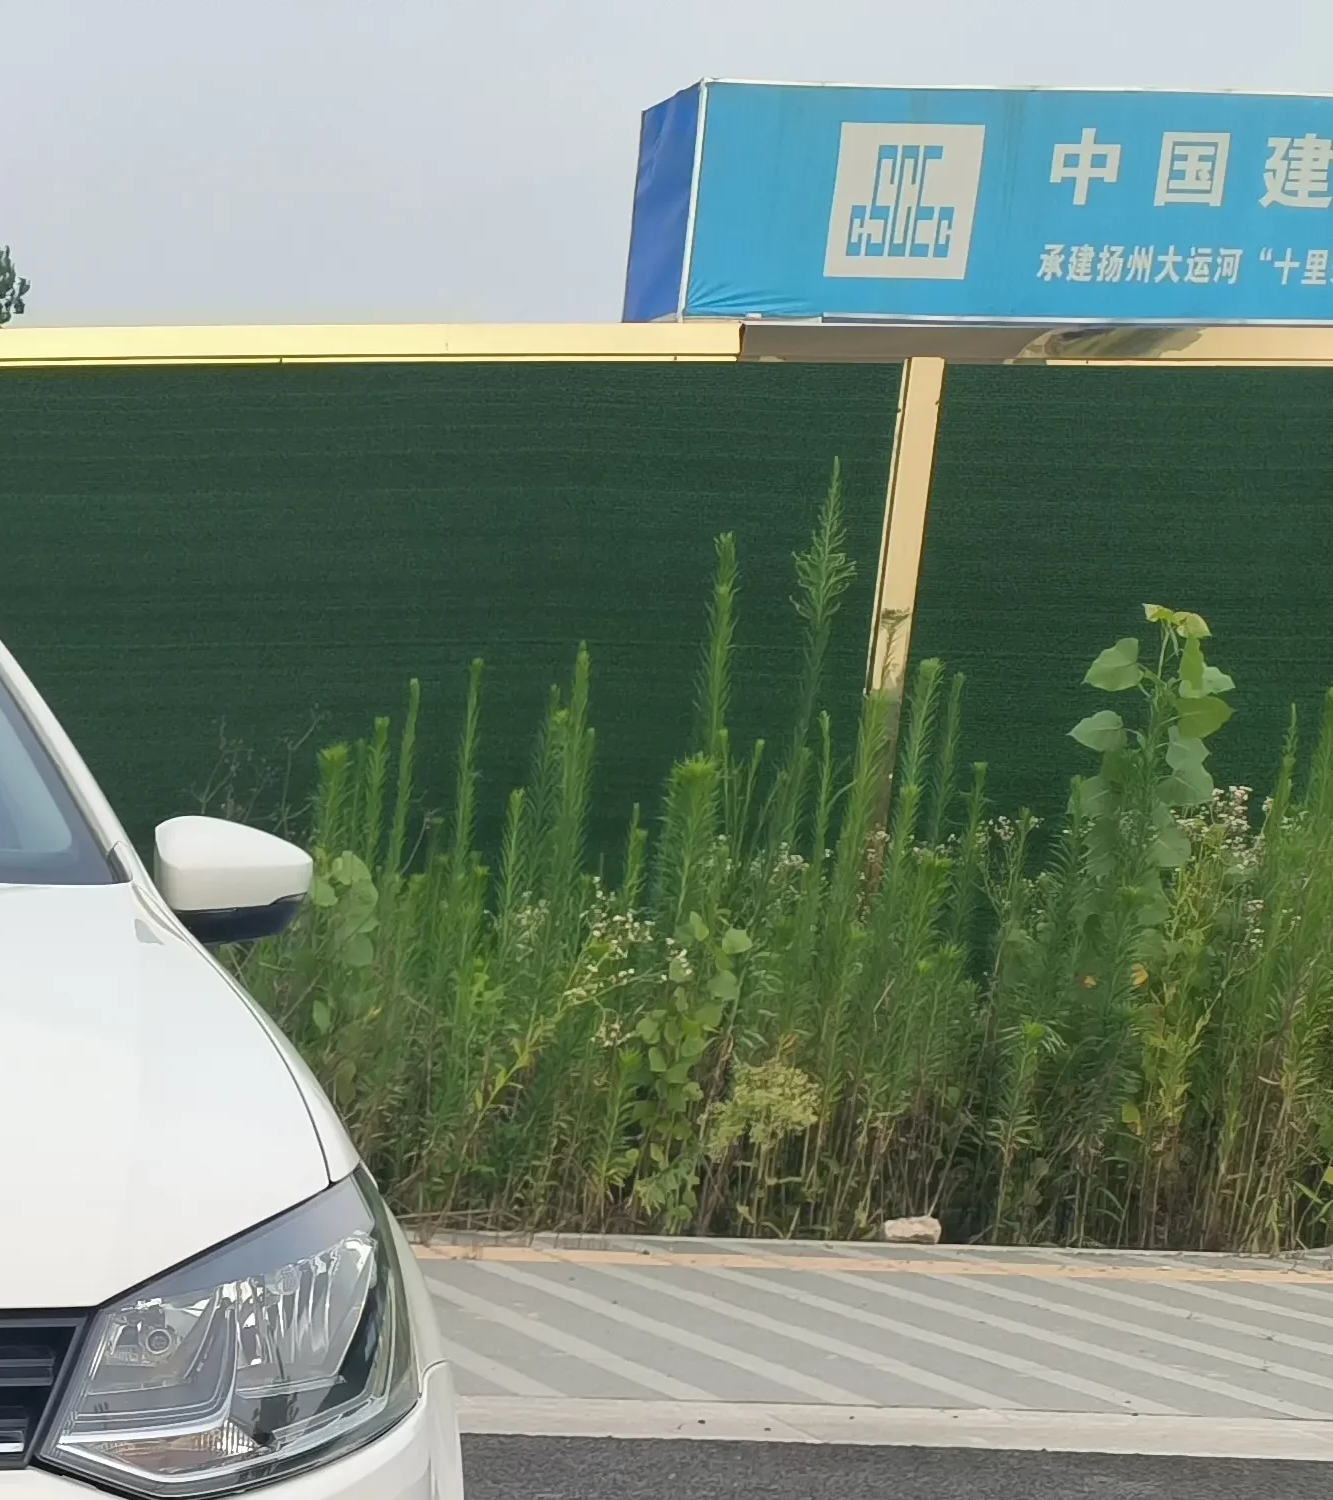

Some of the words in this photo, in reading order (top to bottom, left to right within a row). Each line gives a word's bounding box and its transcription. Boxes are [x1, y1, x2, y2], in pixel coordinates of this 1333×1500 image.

[1036, 243, 1333, 286] 承建扬州大运河“十里
